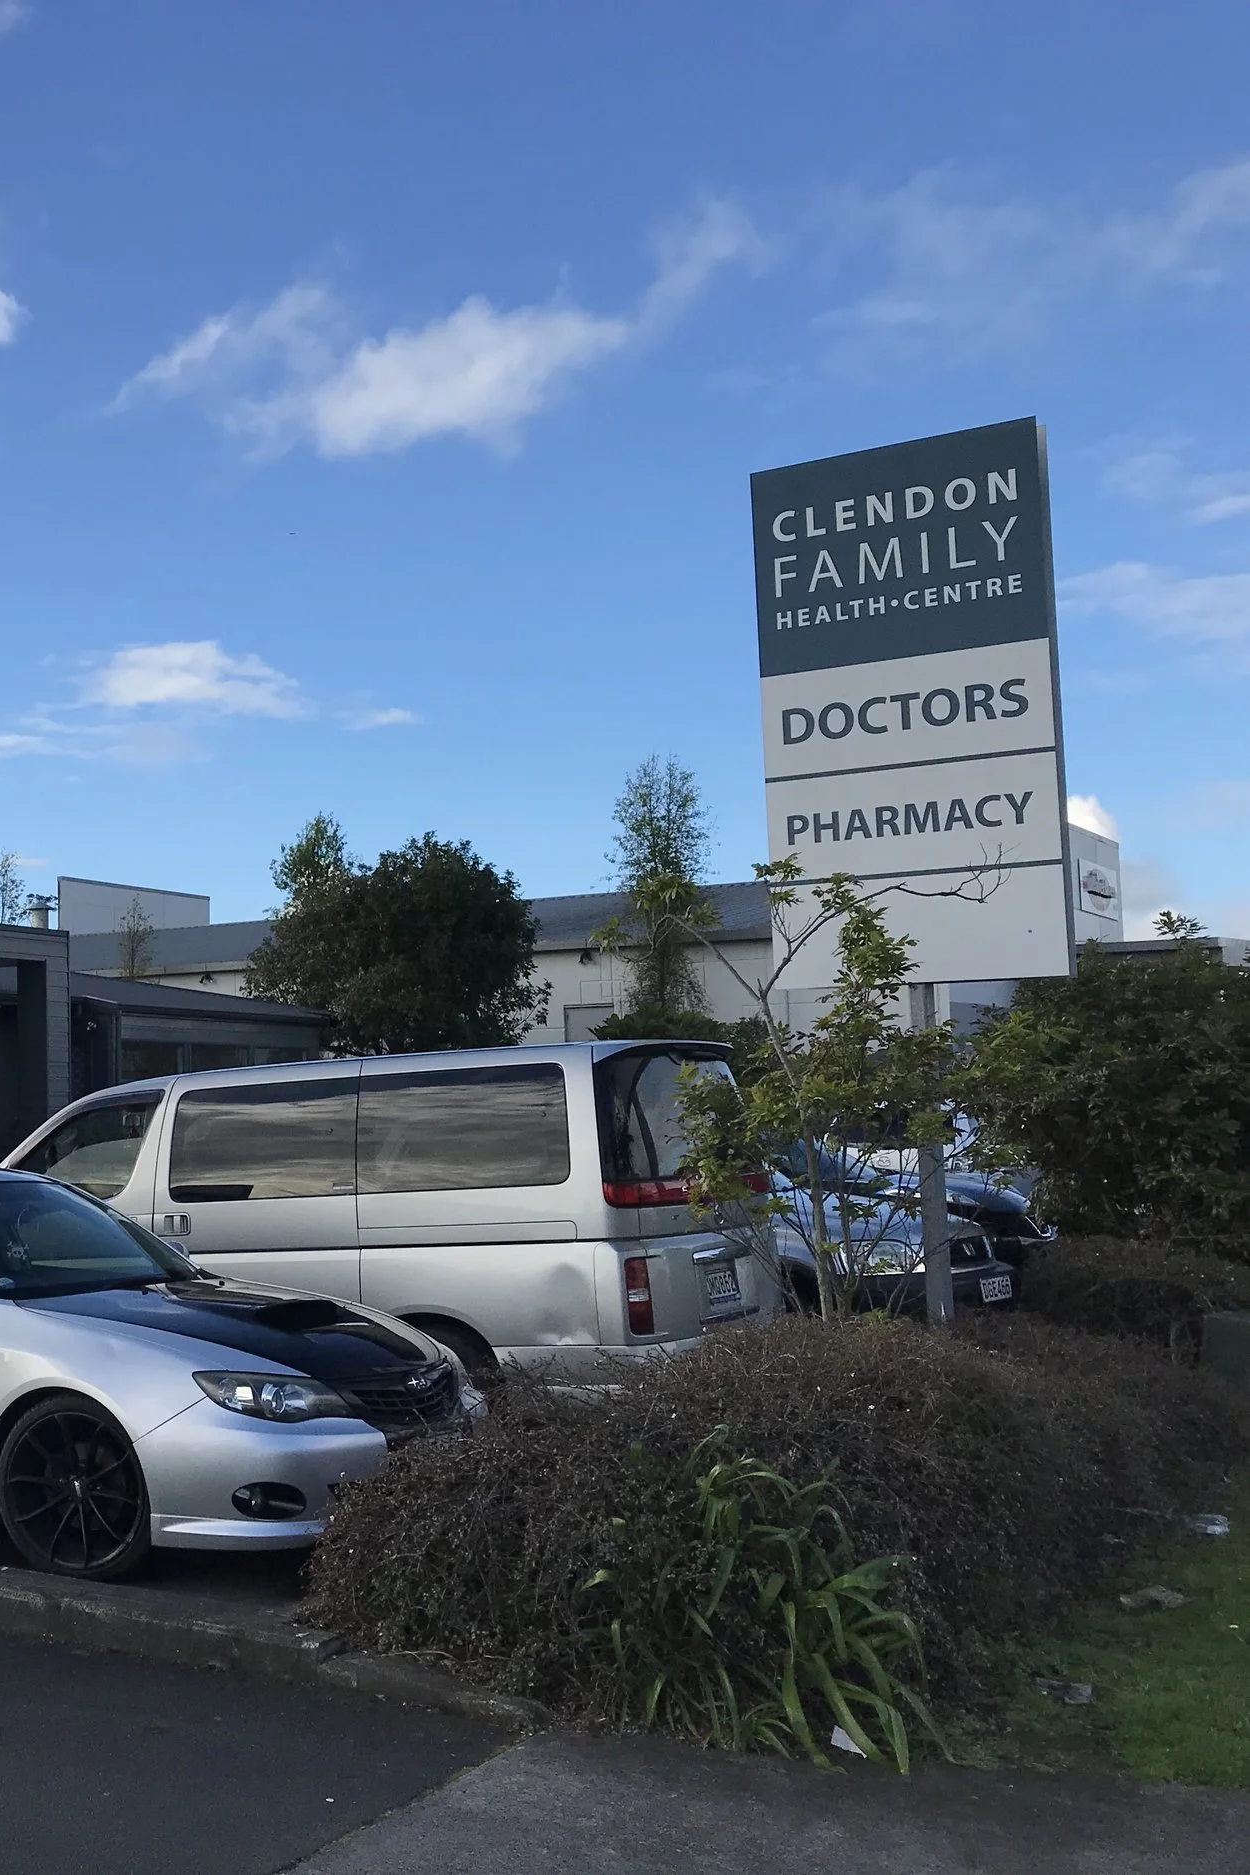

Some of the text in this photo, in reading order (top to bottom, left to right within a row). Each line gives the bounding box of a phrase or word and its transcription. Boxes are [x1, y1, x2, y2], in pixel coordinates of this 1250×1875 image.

[772, 468, 1018, 542] CLENDON
[774, 515, 1018, 598] FAMILY
[781, 678, 1029, 746] DOCTORS
[786, 790, 1034, 846] PHARMACY
